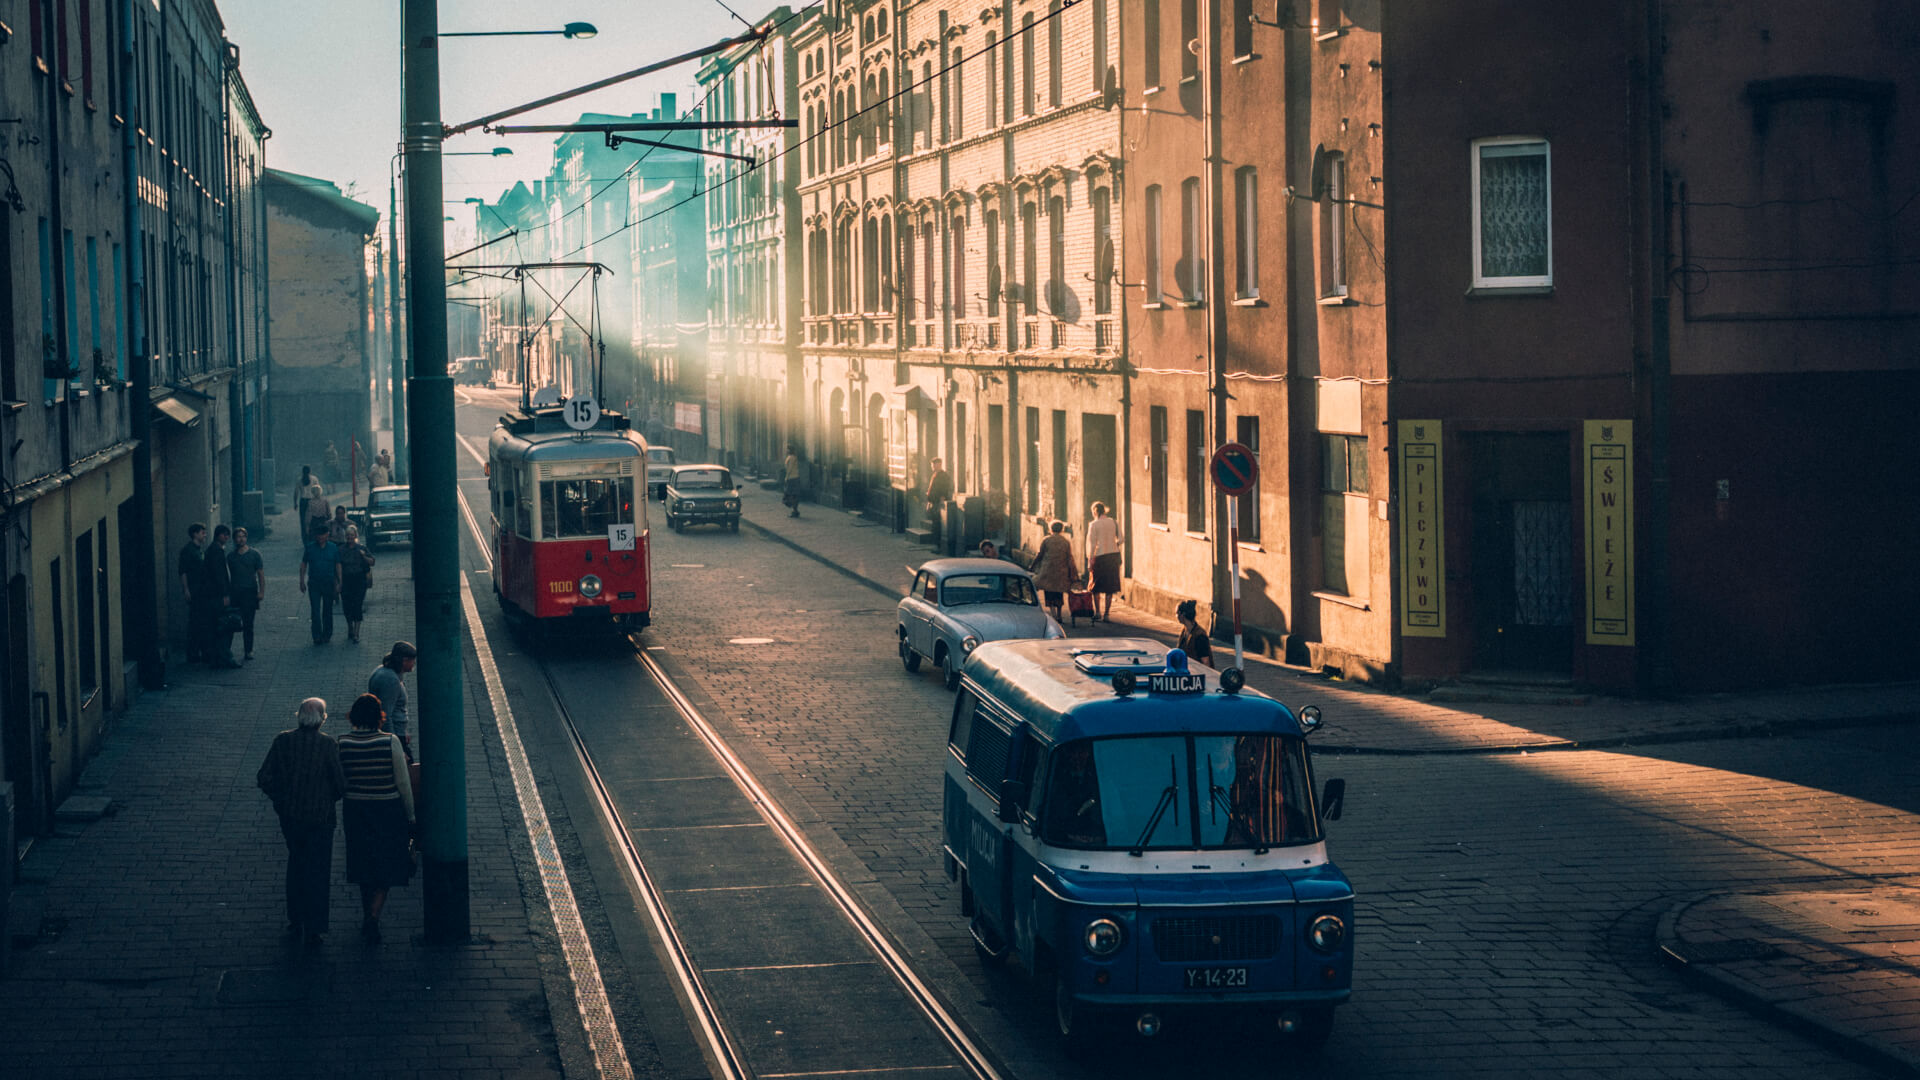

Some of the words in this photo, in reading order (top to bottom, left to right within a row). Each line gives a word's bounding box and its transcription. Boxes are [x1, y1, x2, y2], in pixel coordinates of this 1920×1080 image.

[571, 401, 592, 423] 15
[616, 529, 627, 541] 15
[1416, 463, 1428, 607] PIECZYWO
[1602, 466, 1616, 601] ŚWIEŻE
[549, 581, 573, 593] 1100
[1152, 676, 1203, 691] MILICJA
[971, 819, 996, 868] MILICJA
